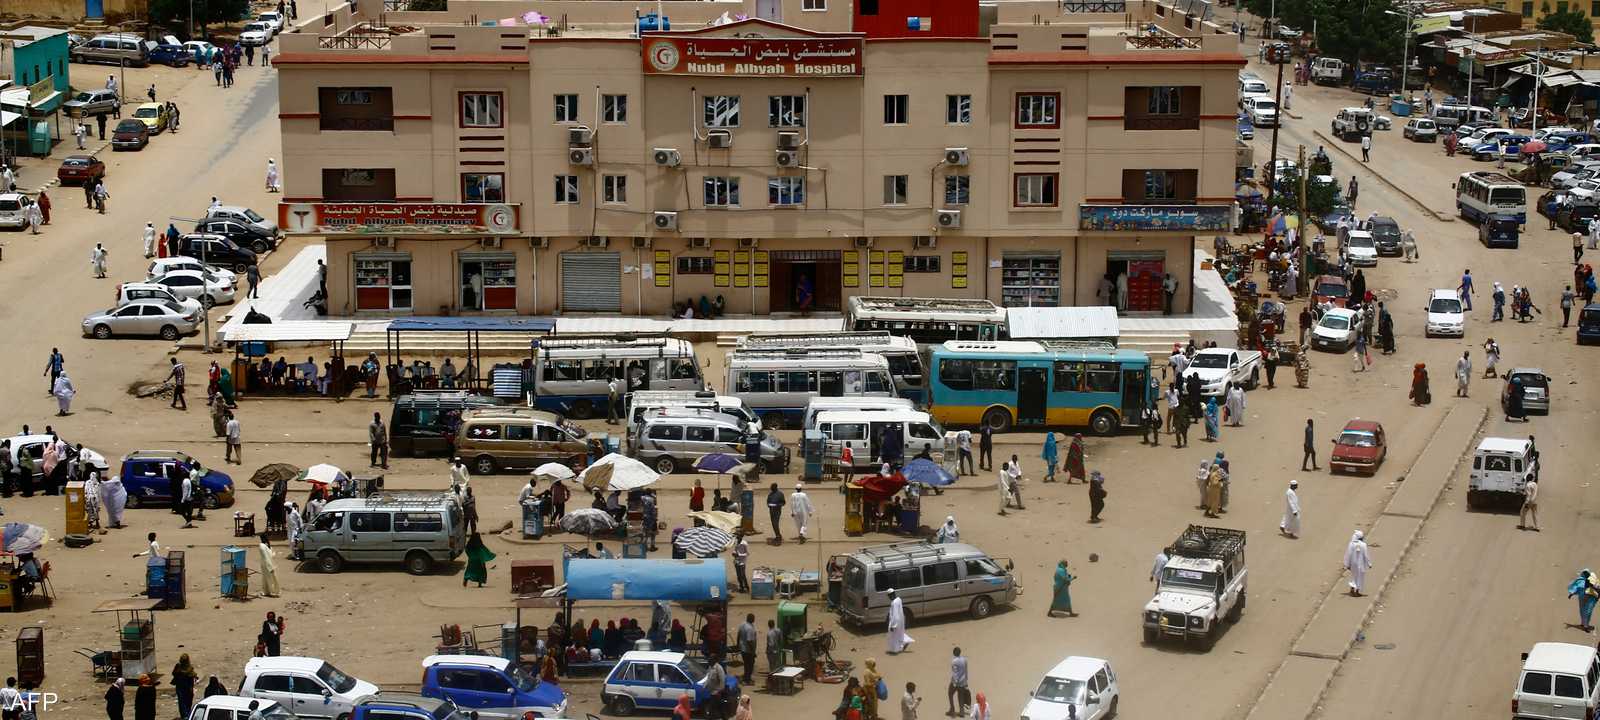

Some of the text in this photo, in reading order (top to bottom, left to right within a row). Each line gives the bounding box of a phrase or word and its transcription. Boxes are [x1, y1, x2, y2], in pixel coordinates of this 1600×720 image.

[755, 43, 790, 61] نبض
[687, 62, 856, 74] Nubd Alhyah Hospital
